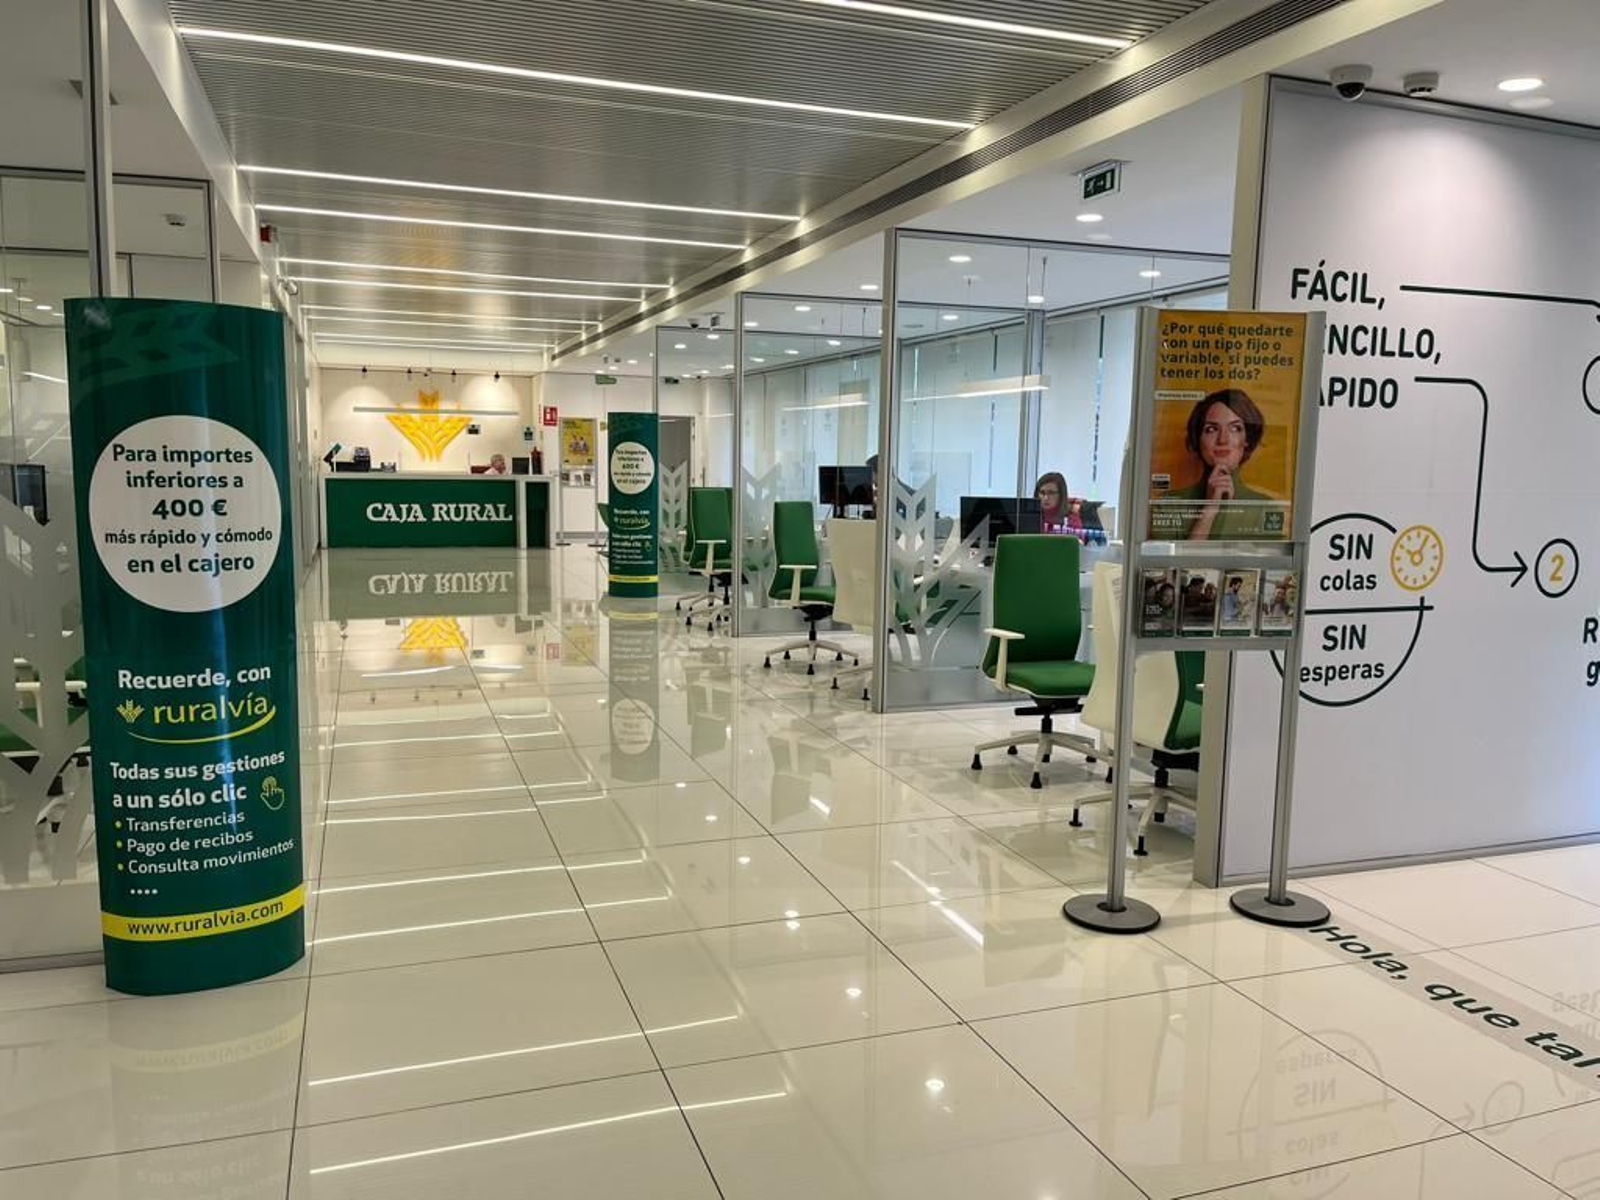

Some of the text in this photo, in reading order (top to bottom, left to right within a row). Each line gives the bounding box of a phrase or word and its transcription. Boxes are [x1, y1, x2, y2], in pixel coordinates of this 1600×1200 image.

[1290, 259, 1386, 310] FÁCIL,
[1162, 322, 1294, 338] ¿Por qué quedarte
[1162, 338, 1282, 353] con un tipo fijo o
[1324, 324, 1442, 365] NCILLO,
[1161, 352, 1225, 365] variable,
[1244, 354, 1294, 367] puedes
[1160, 367, 1261, 380] tener los dos?
[1320, 377, 1399, 409] PIDO
[113, 444, 254, 468] Para importes
[126, 470, 244, 488] inferiores a
[152, 498, 228, 520] 400 €
[366, 502, 513, 523] CAJA RURAL
[105, 528, 272, 548] más rápido y cómodo
[1328, 533, 1374, 560] SIN
[127, 553, 255, 577] en el cajero
[1549, 554, 1564, 582] 2
[1319, 569, 1377, 591] colas
[1322, 624, 1367, 651] SIN
[118, 666, 271, 689] Recuerde, con
[1299, 662, 1385, 687] esperas
[1586, 661, 1600, 687] g
[153, 692, 269, 724] ruralvía
[110, 750, 286, 781] Todas sus gestiones
[112, 783, 248, 809] a un sólo clic
[126, 811, 246, 832] Transferencias
[126, 830, 254, 856] Pago de recibos
[128, 838, 295, 874] Consulta movimientos
[127, 901, 284, 935] www.ruralvia.com
[1309, 926, 1409, 979] Hola,
[1424, 984, 1520, 1028] que
[1524, 1032, 1600, 1078] tal
